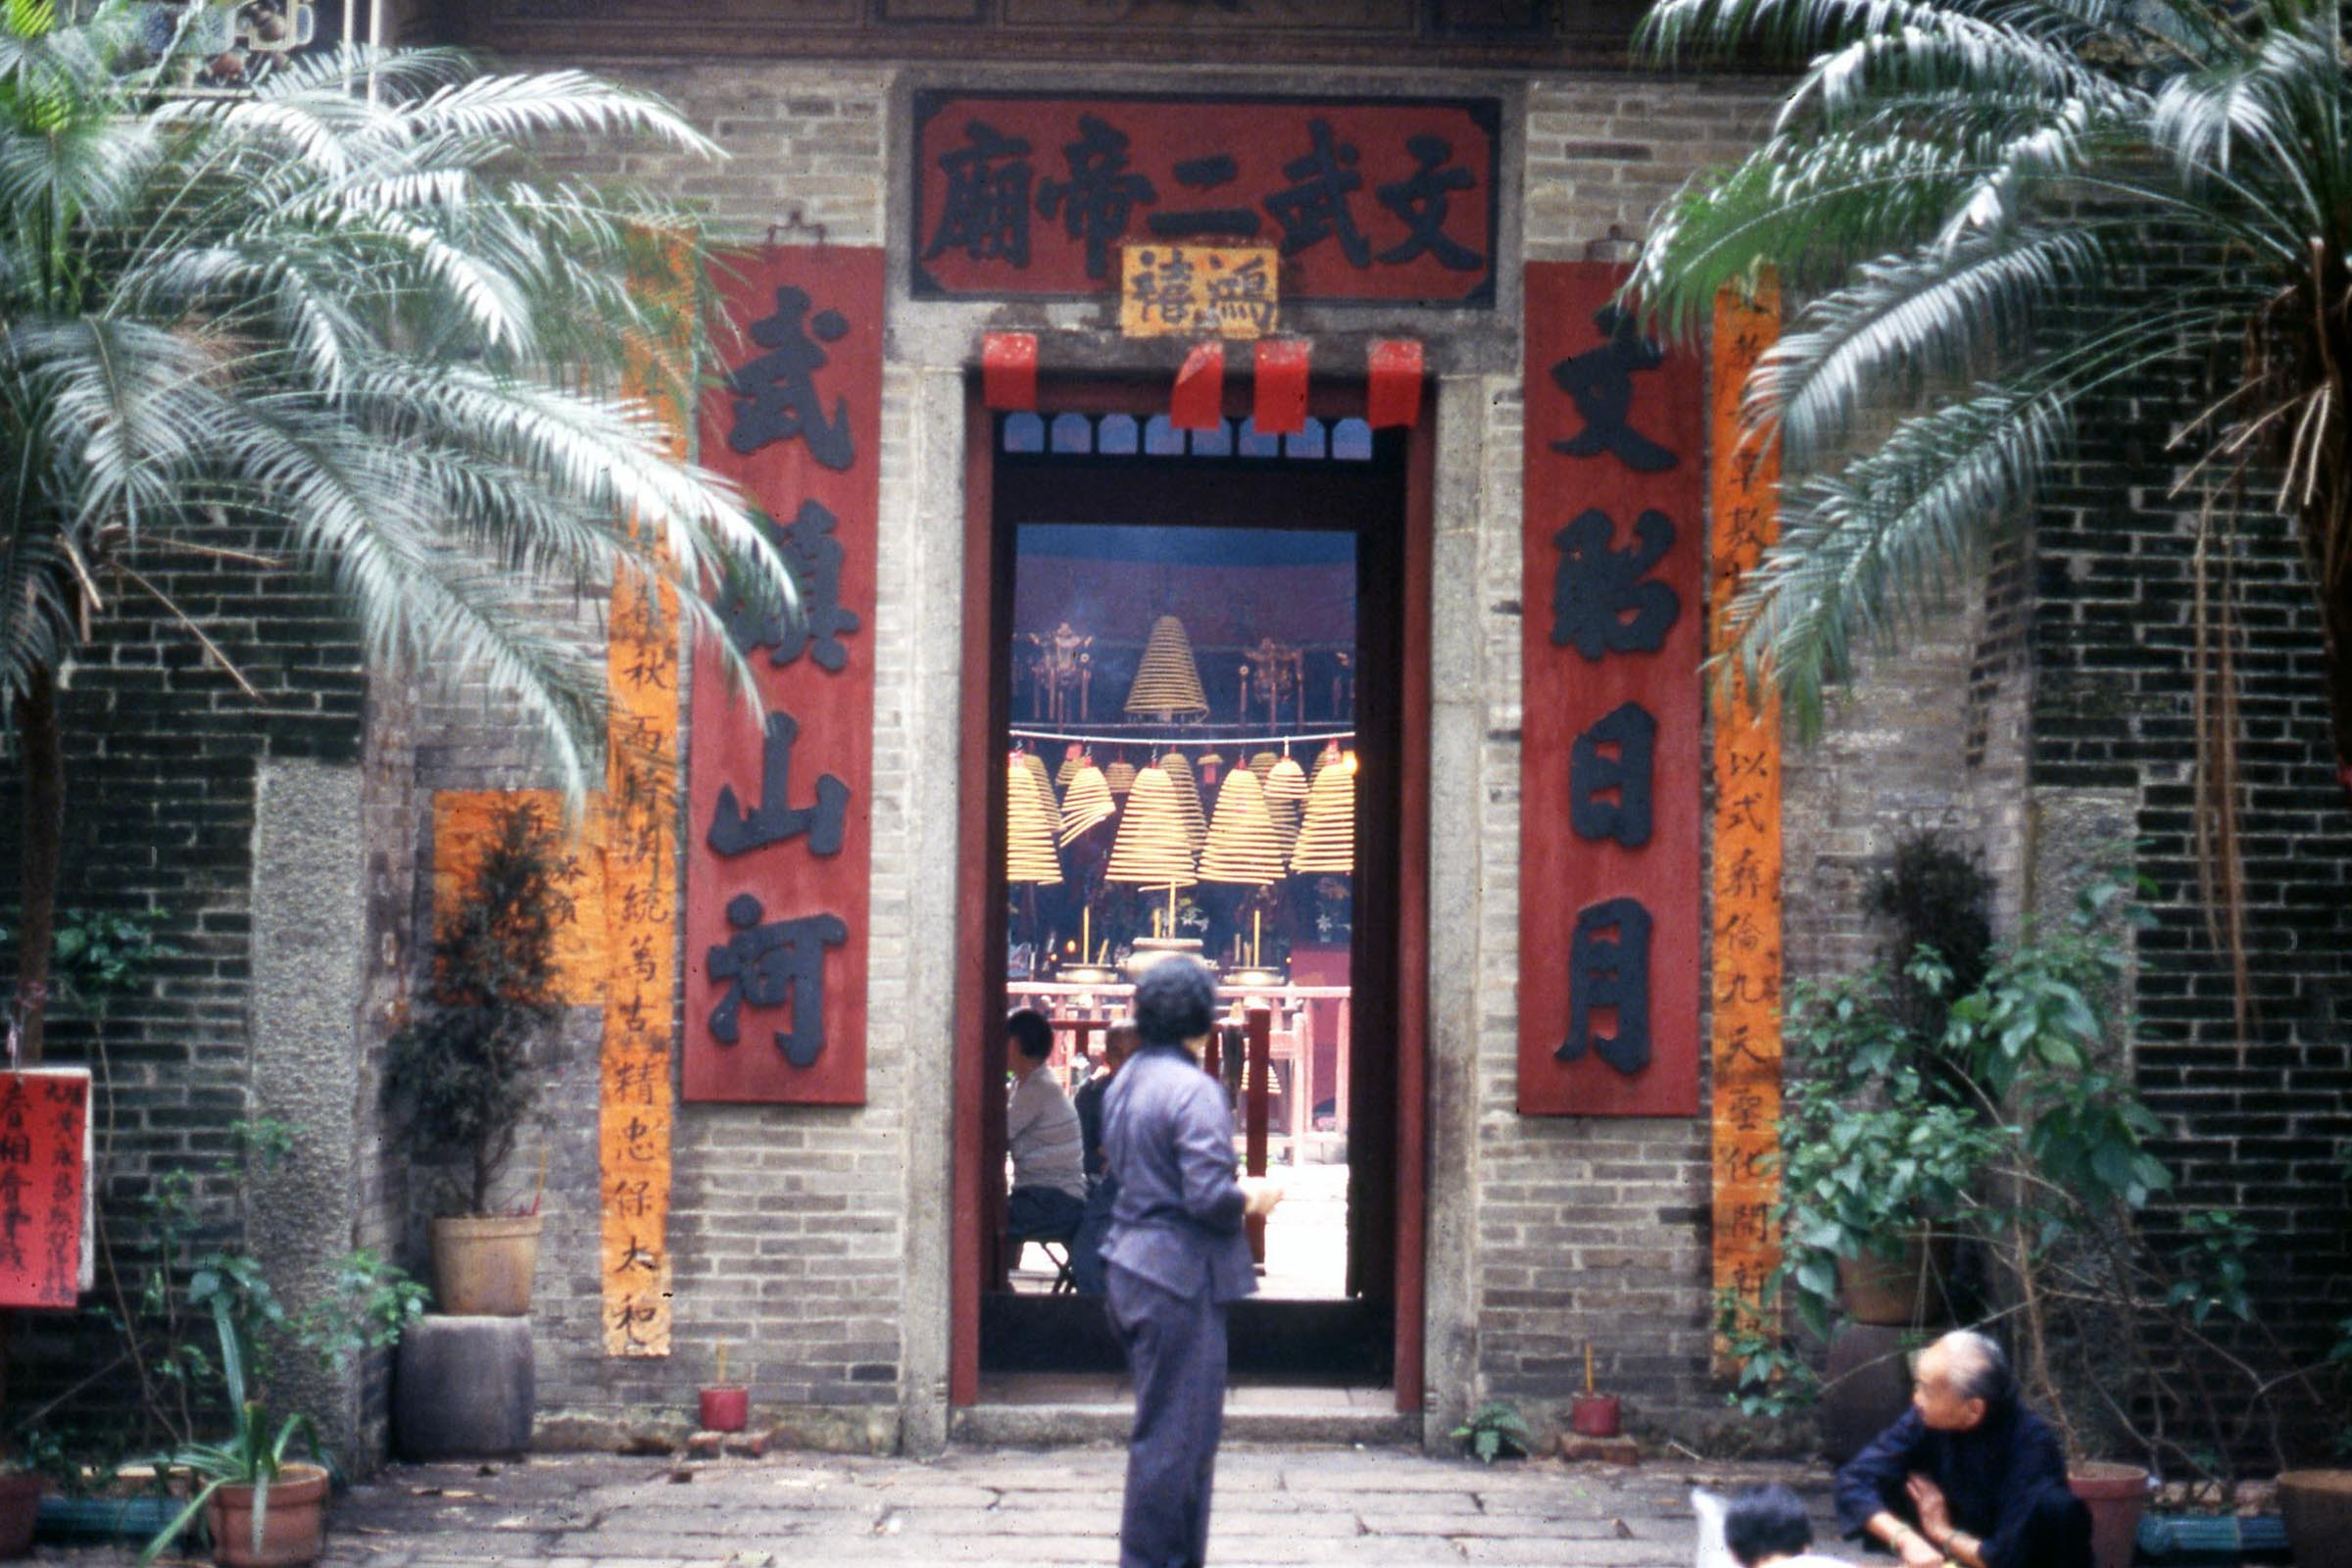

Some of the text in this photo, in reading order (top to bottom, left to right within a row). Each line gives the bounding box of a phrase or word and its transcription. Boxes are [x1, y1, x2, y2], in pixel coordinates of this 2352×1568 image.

[922, 113, 1484, 276] 文武二帝廟
